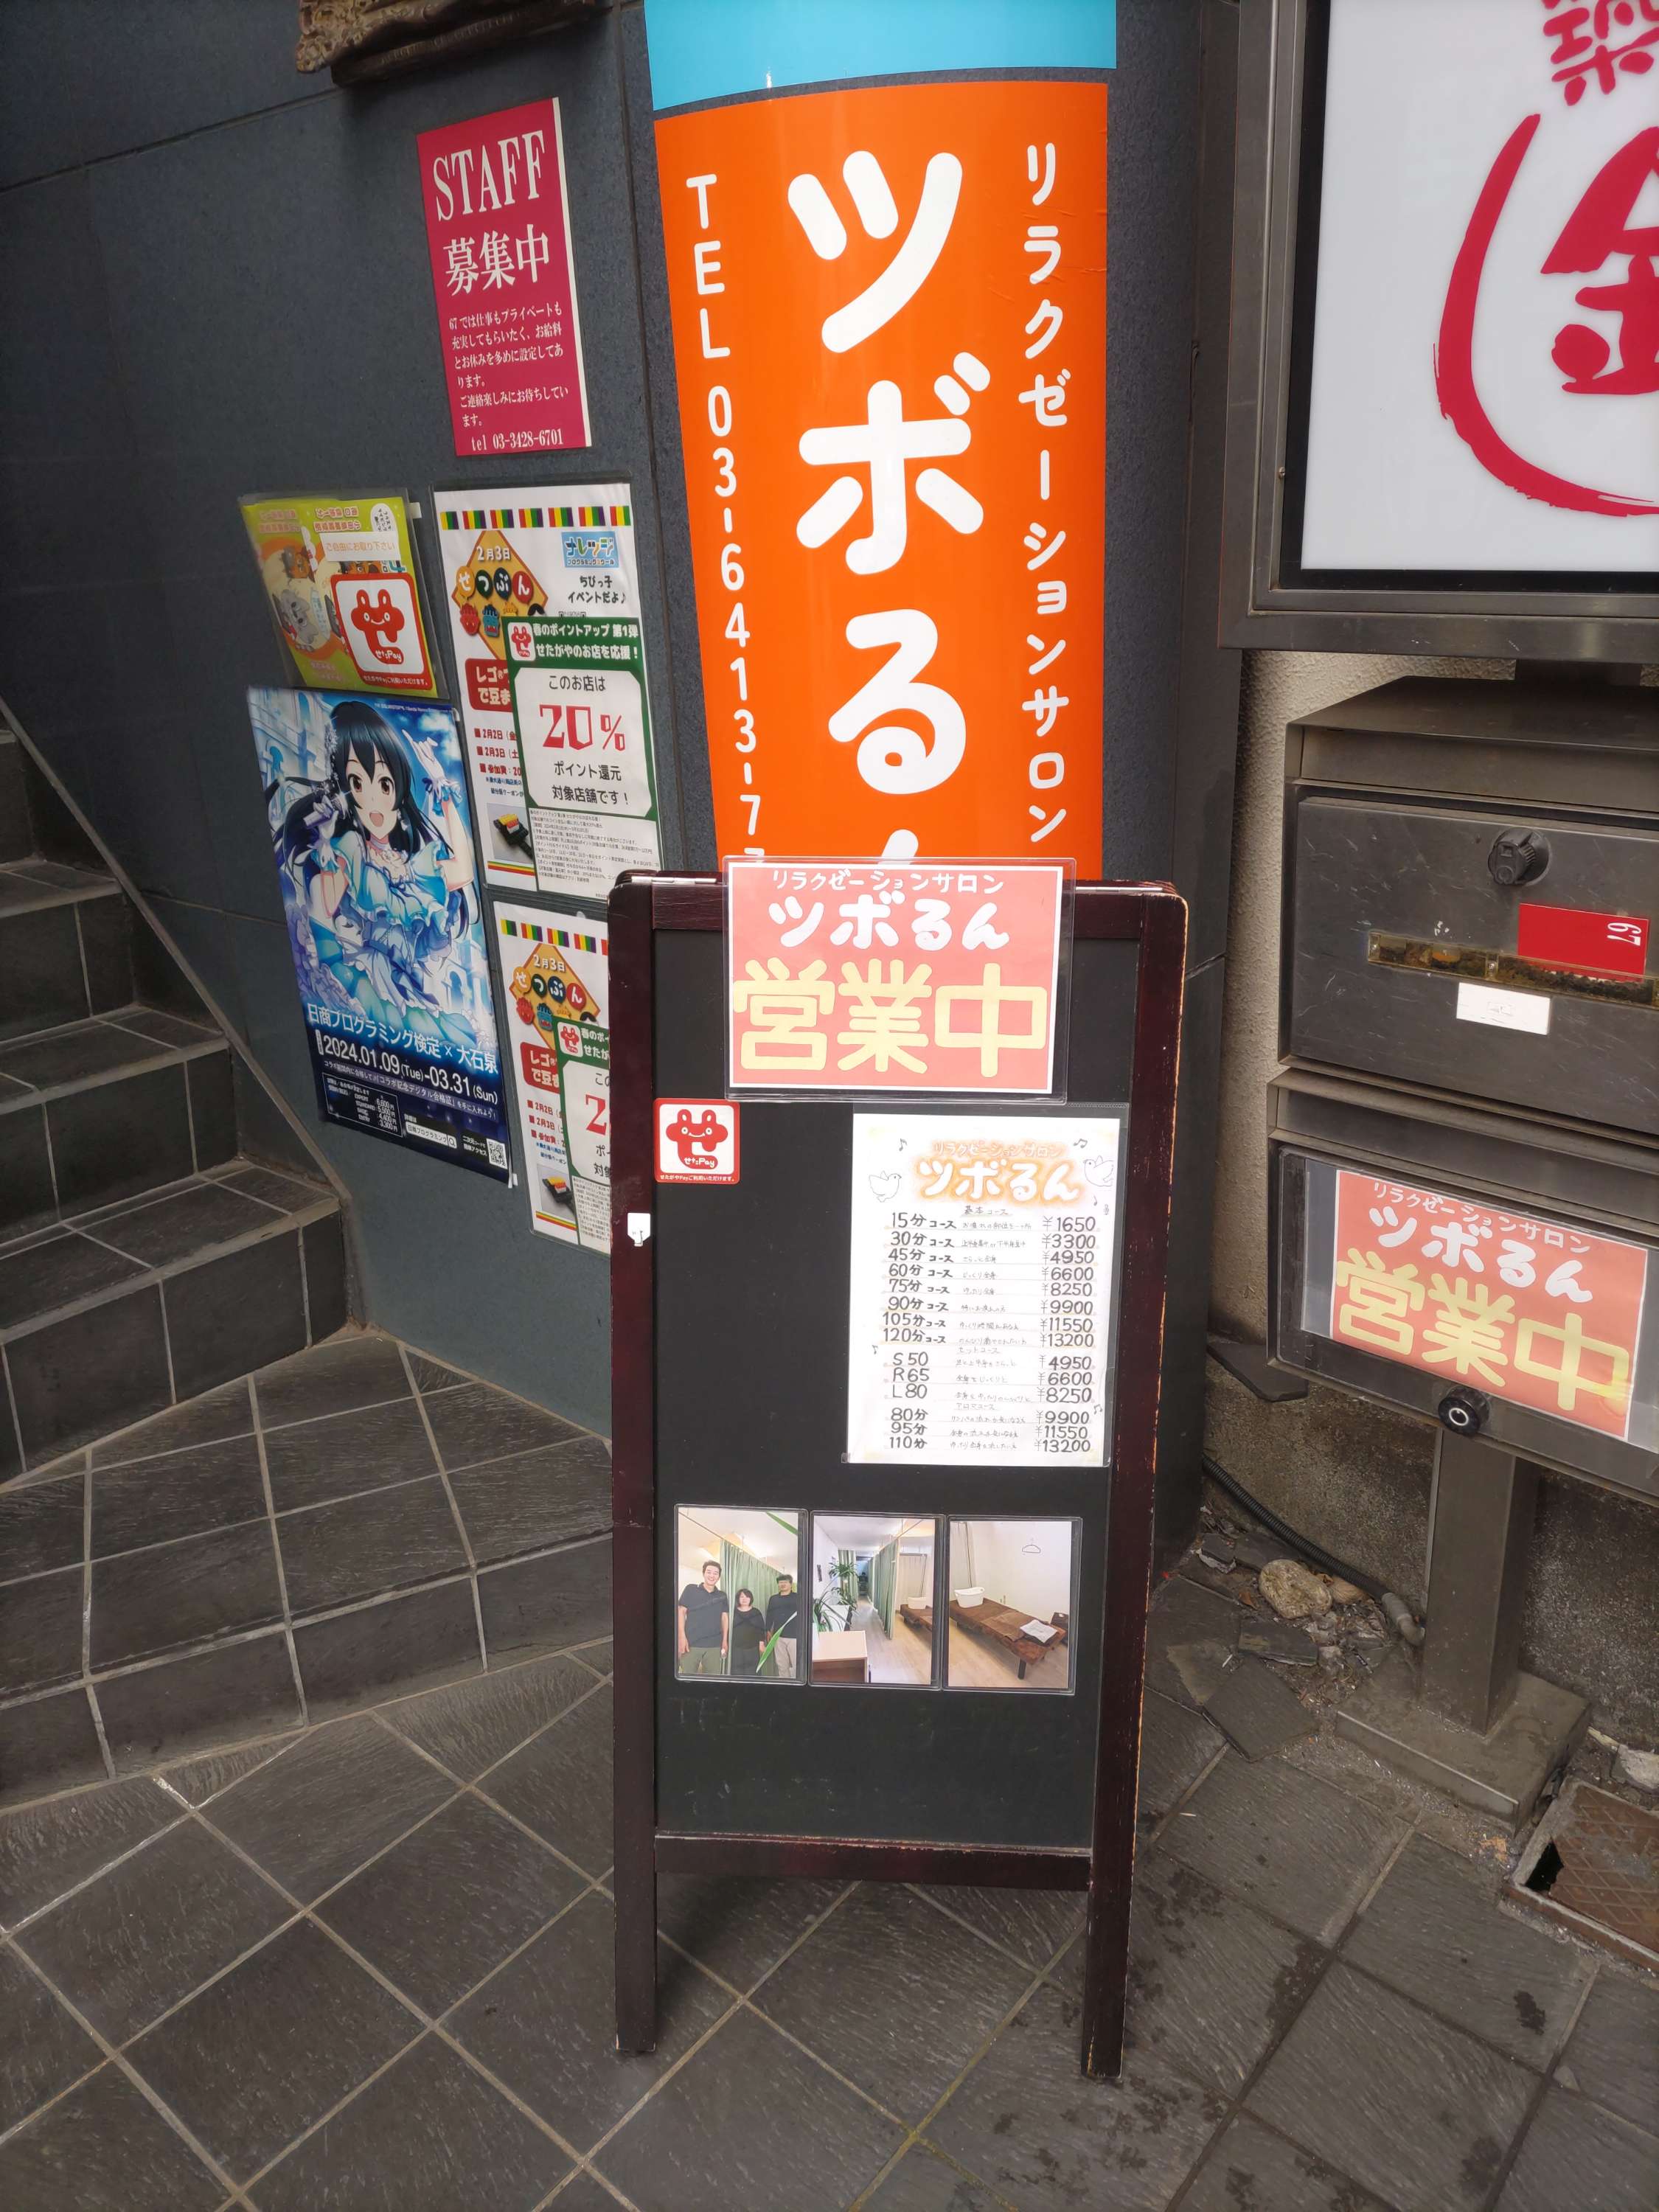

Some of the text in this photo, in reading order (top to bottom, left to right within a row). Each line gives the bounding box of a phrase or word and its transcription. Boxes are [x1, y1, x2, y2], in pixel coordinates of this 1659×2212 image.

[433, 130, 545, 221] STAFF
[443, 224, 550, 296] 募集中
[451, 321, 563, 350] 充実してもらいたく、お給料
[454, 343, 563, 370] とお休みを多めに設定してあ
[457, 374, 486, 389] ります。
[460, 386, 569, 408] ご連絡楽しみにお待ちしてい
[462, 413, 482, 428] ます。
[471, 428, 564, 451] tel 03-3428-6701
[1018, 142, 1071, 843] リラクゼーションサロン
[686, 174, 765, 861] TEL 03-6413-7
[786, 150, 991, 868] ツボる
[476, 546, 512, 562] 2月3日
[458, 568, 529, 597] せつぶん
[580, 575, 612, 588] ちびっ子
[549, 675, 606, 692] このお店は
[539, 703, 626, 752] 20%
[554, 761, 622, 782] ポイント還元
[772, 868, 1004, 894] リラクゼーションサロン
[768, 890, 1010, 951] ツボるん
[533, 954, 566, 973] 2月3日
[517, 972, 582, 1004] せつぶん
[733, 957, 1048, 1078] 営業中
[307, 1004, 441, 1059] 日商プログラミング検定
[456, 1046, 498, 1074] 大石泉
[918, 1158, 1080, 1202] ツボるん
[1374, 1181, 1590, 1254] リラクゼーションサロン
[1368, 1206, 1593, 1303] ツボるん
[1335, 1248, 1630, 1411] 営業中
[890, 1422, 928, 1436] 95分
[891, 1407, 928, 1422] 80分
[889, 1436, 928, 1450] 110分
